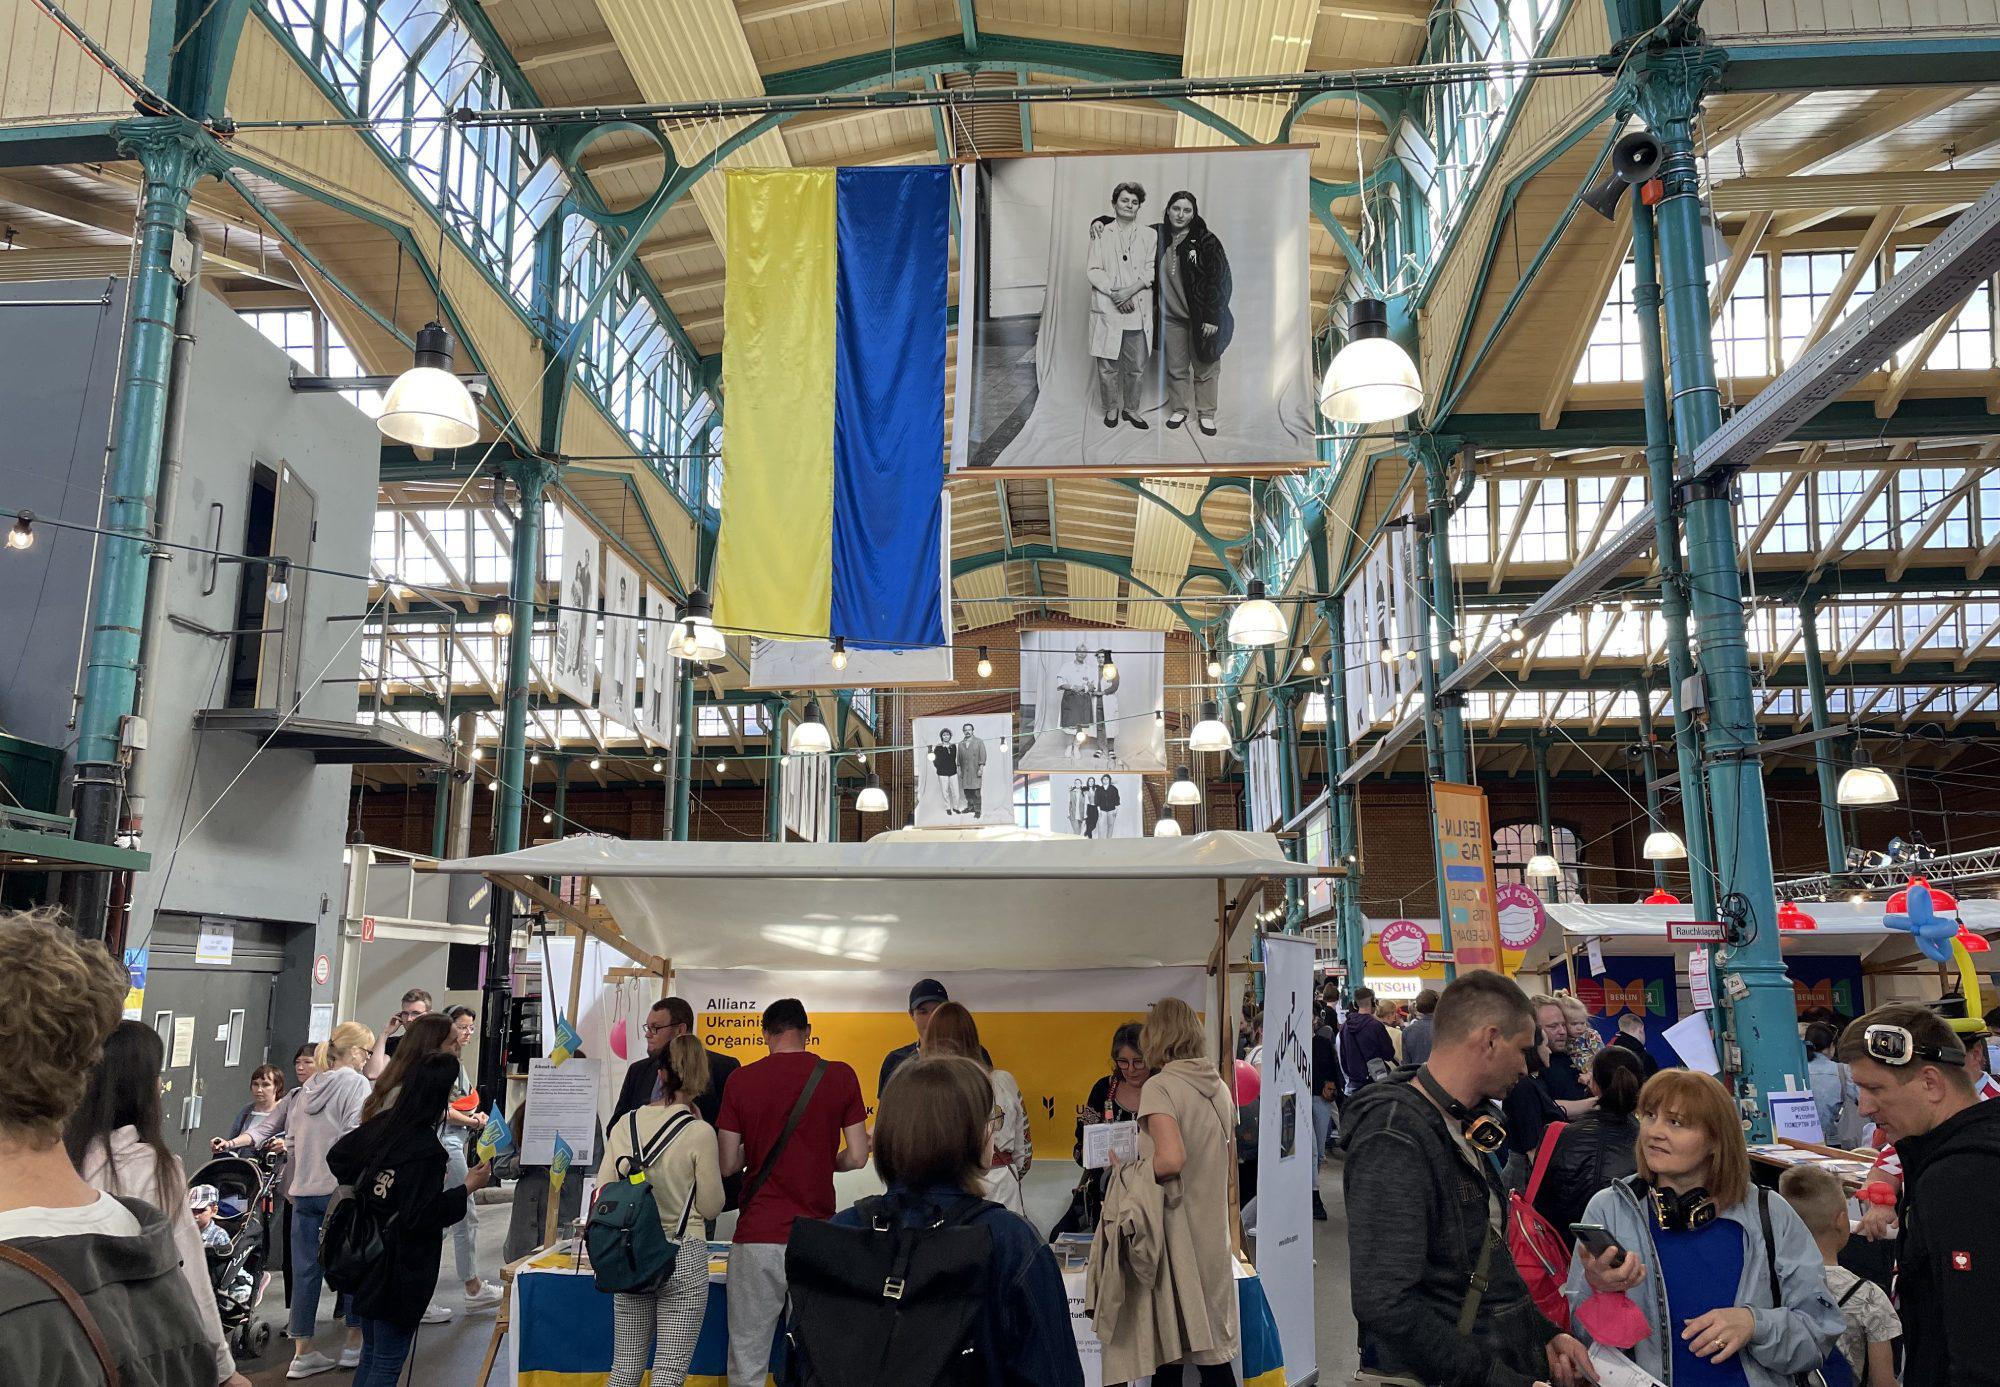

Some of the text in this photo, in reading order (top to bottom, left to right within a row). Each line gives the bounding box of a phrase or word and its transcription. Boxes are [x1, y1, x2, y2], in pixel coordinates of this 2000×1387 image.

[1514, 889, 1539, 914] FOOD
[1405, 925, 1426, 943] FOOD
[1676, 926, 1721, 938] Rauchklappe
[1729, 980, 1740, 988] Zu
[1609, 993, 1638, 1001] BERLIN
[1797, 993, 1825, 1001] BERLIN
[706, 997, 756, 1010] Allianz
